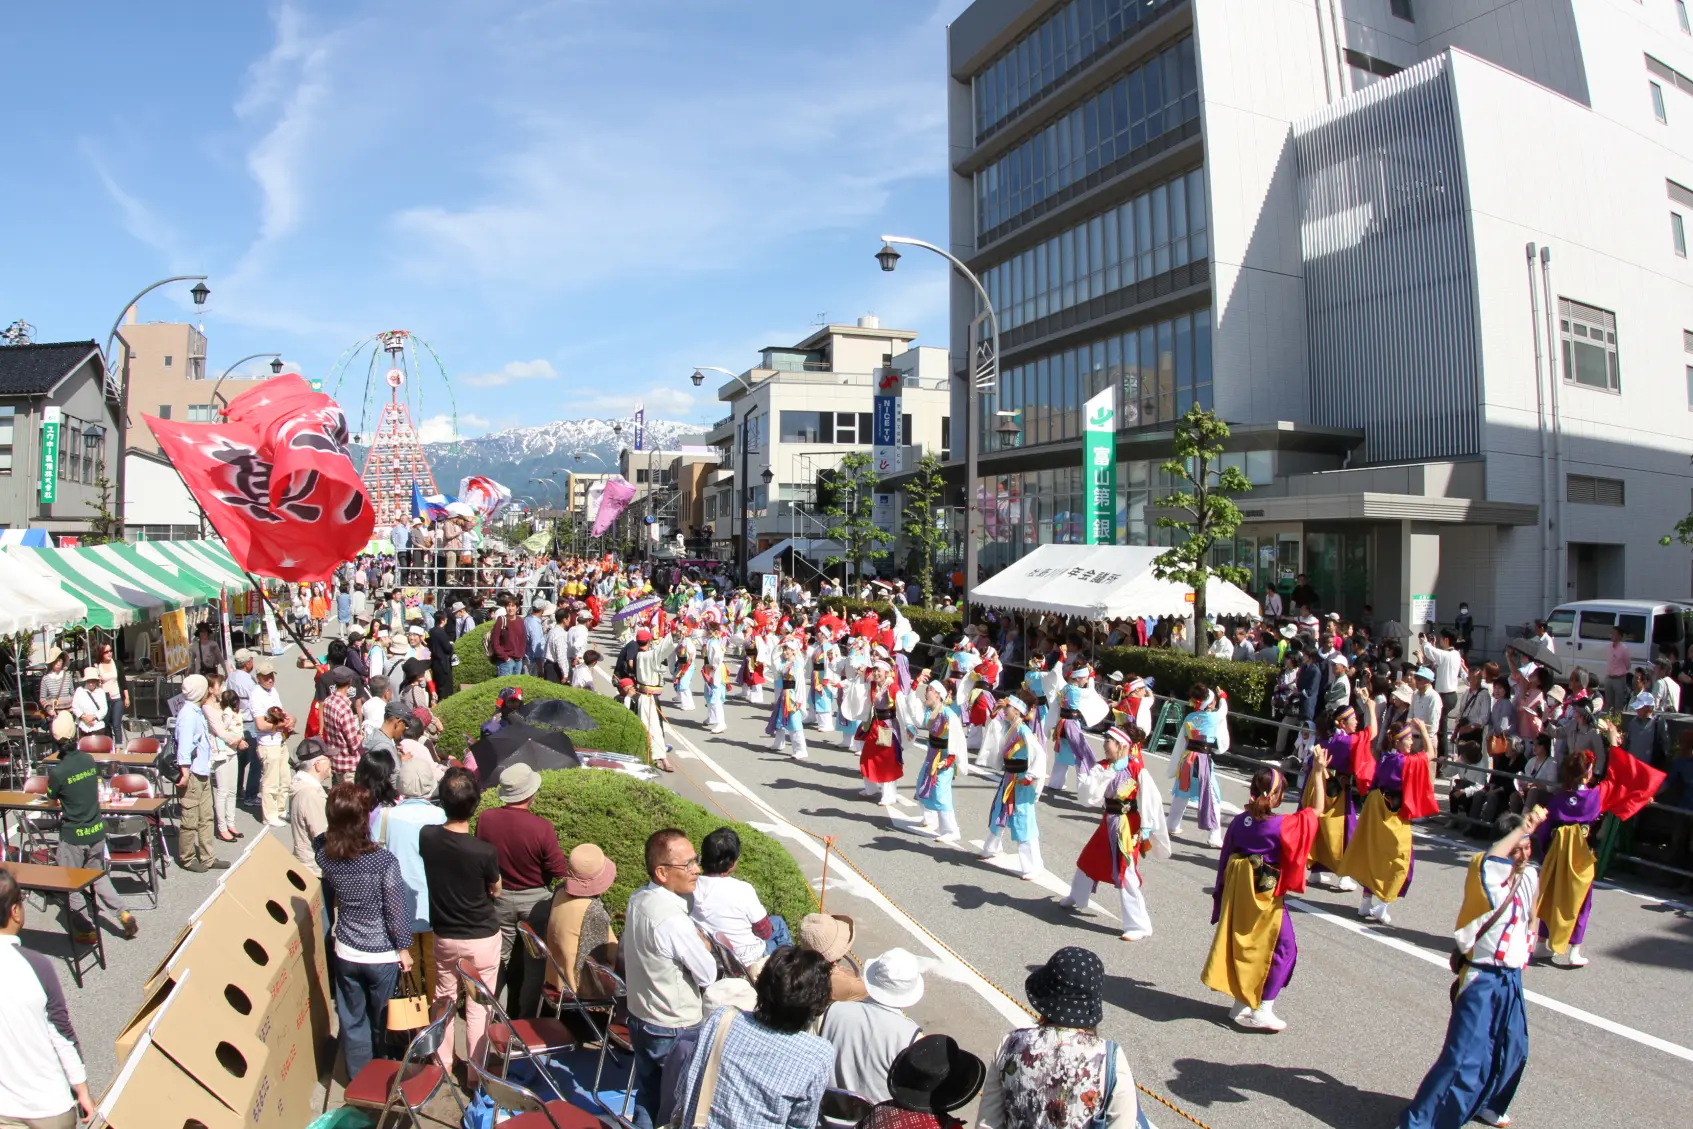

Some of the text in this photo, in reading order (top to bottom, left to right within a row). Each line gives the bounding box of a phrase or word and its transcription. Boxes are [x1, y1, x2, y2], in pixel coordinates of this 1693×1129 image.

[883, 400, 891, 442] NICE TV
[1093, 446, 1110, 545] 富山第一銀
